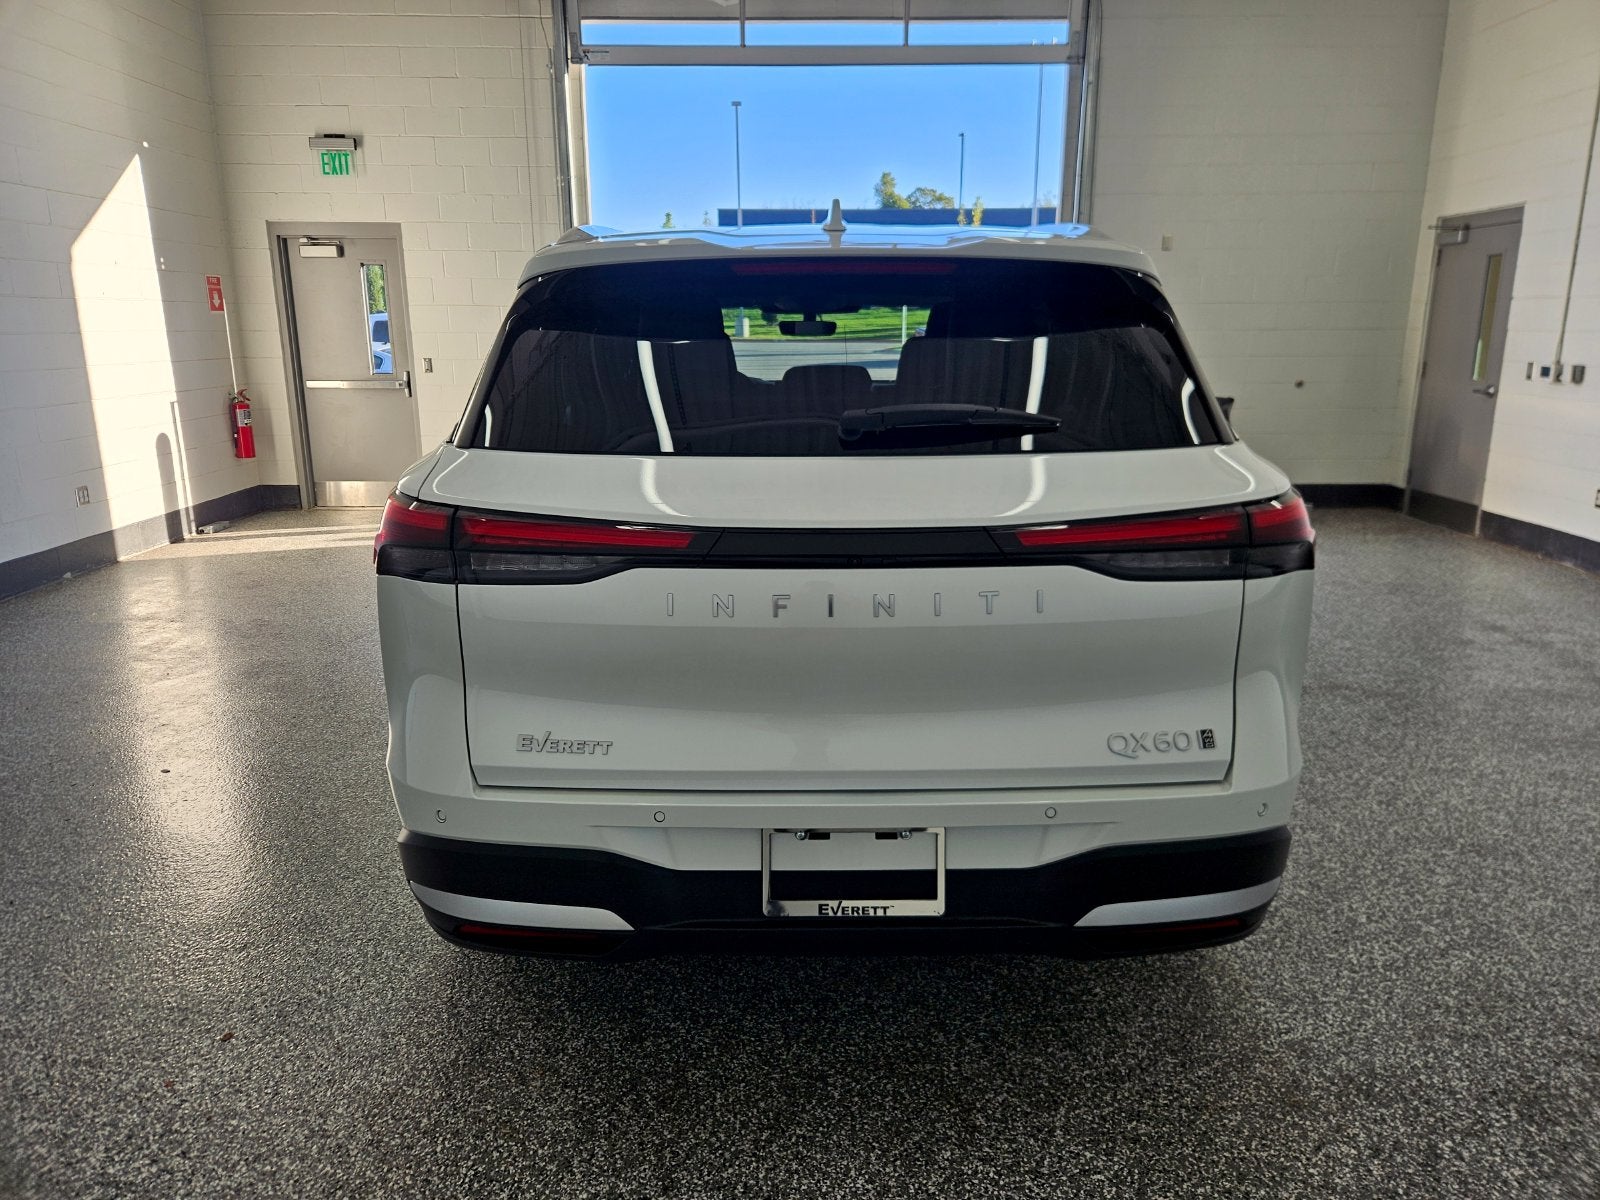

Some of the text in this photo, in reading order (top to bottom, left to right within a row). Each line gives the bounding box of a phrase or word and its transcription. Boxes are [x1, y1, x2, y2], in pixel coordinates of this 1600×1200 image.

[321, 152, 350, 175] EXIT
[666, 589, 1044, 618] INFINITI
[516, 731, 613, 755] EVERETT
[1107, 730, 1192, 759] QX60
